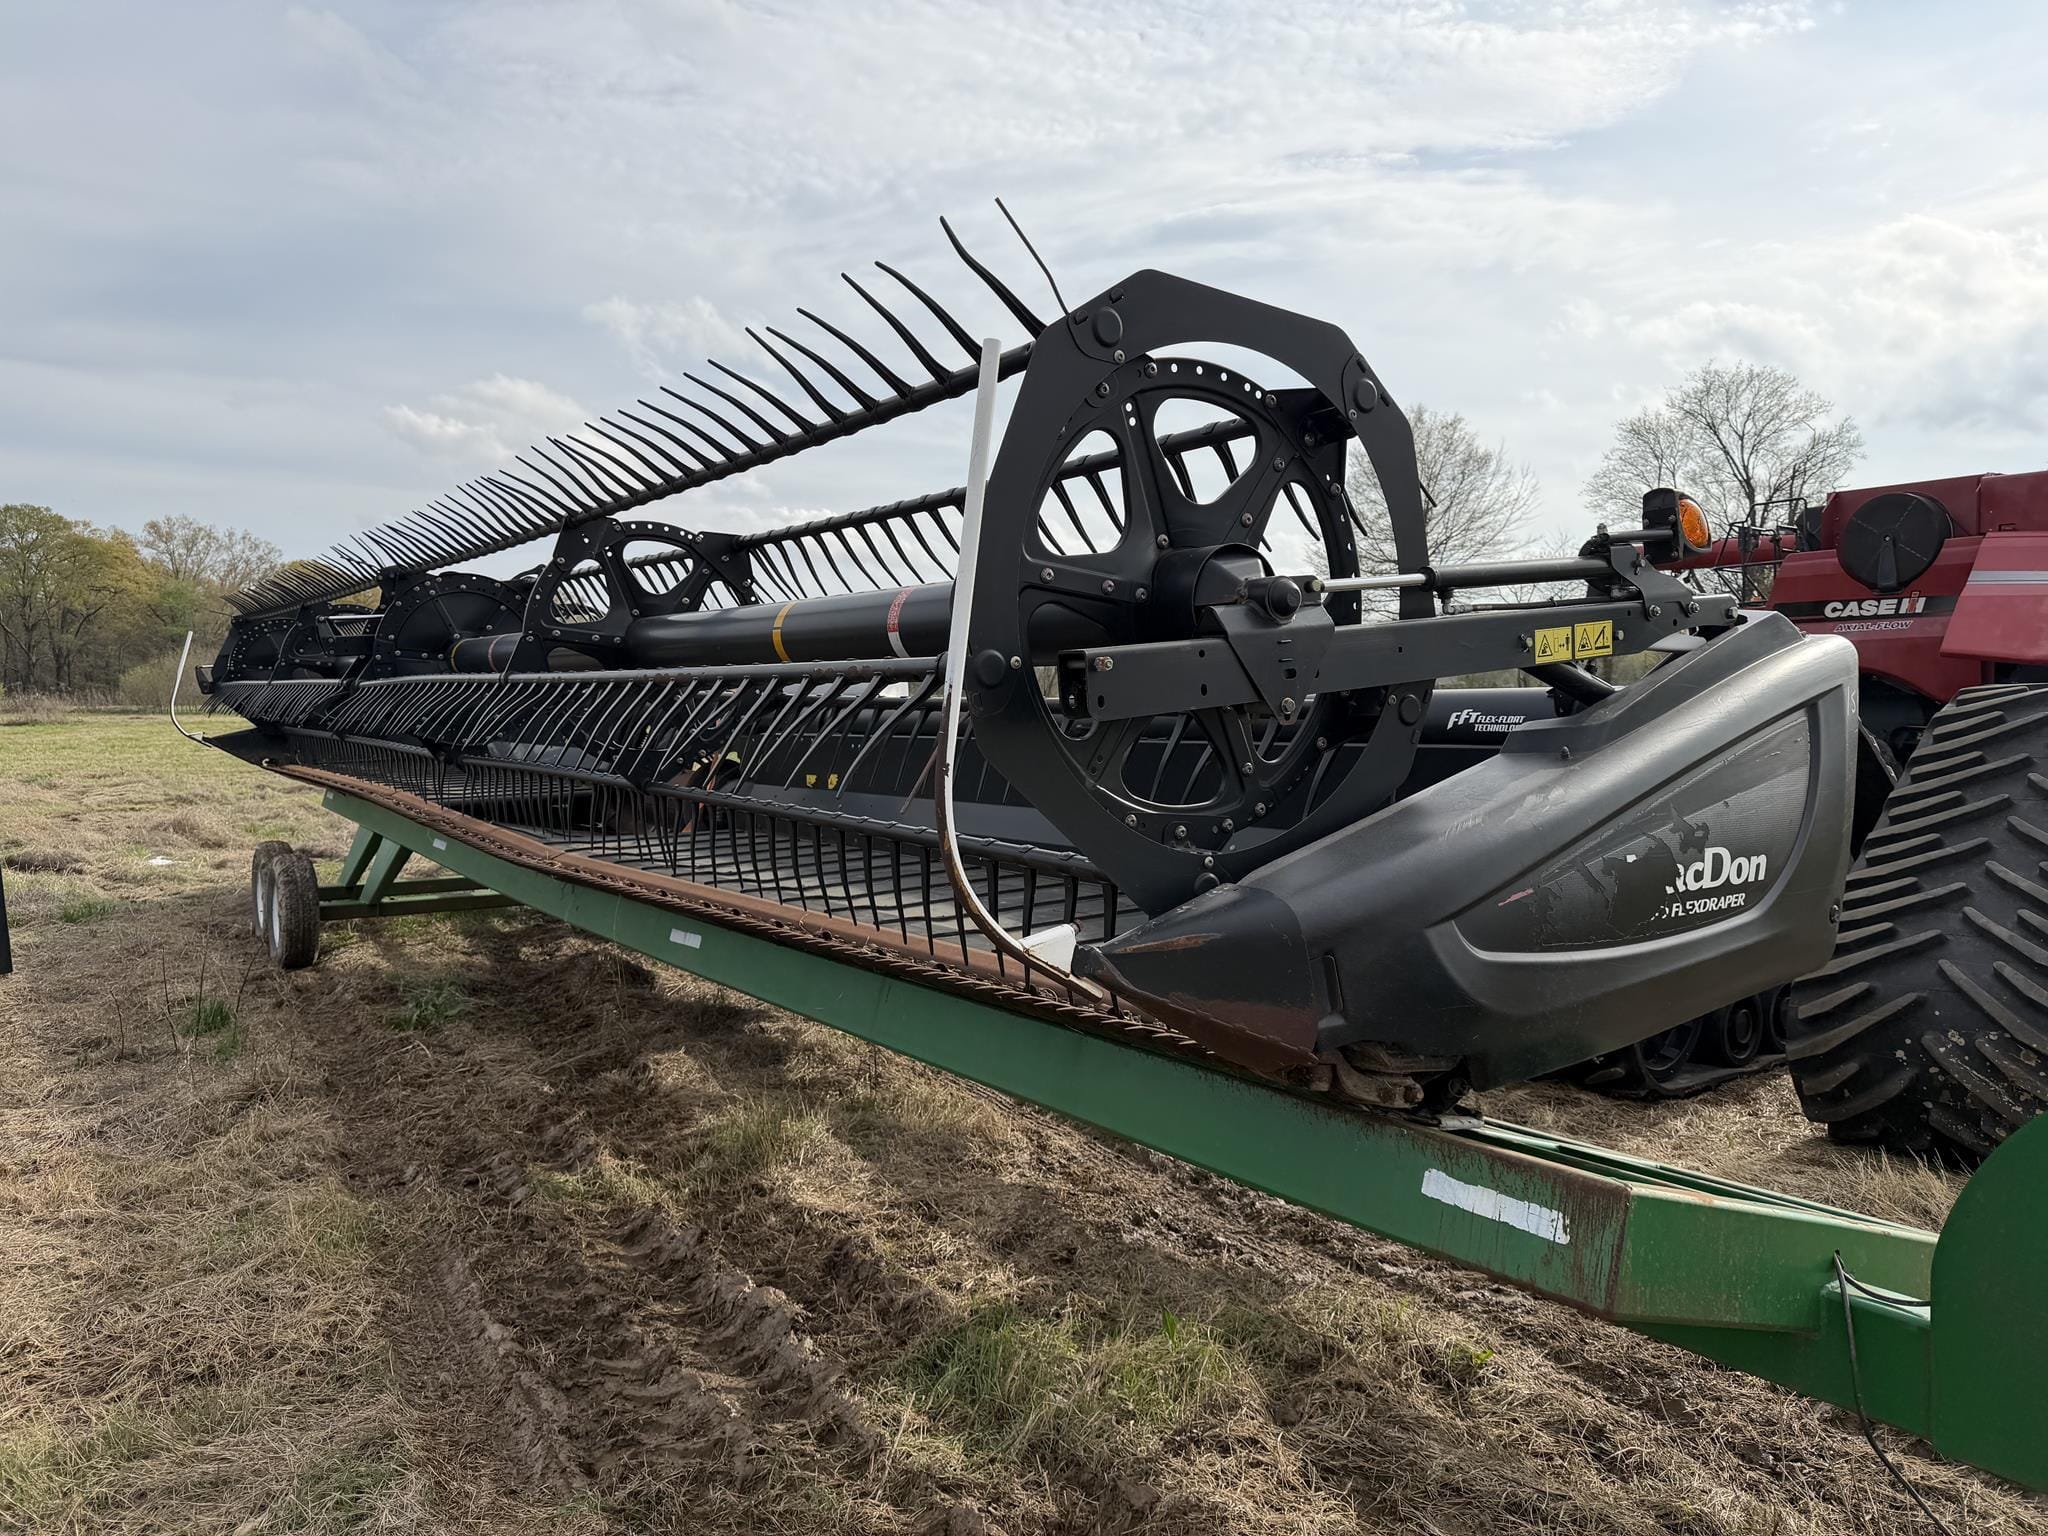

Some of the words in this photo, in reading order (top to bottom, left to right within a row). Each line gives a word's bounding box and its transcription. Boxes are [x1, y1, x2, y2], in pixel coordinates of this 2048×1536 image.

[1823, 597, 1898, 618] CASE
[1833, 620, 1914, 632] AXIAL-FLOW
[1447, 709, 1481, 730] FFT
[1477, 715, 1526, 724] FLEX-FLOAT
[1665, 846, 1767, 894] acDon
